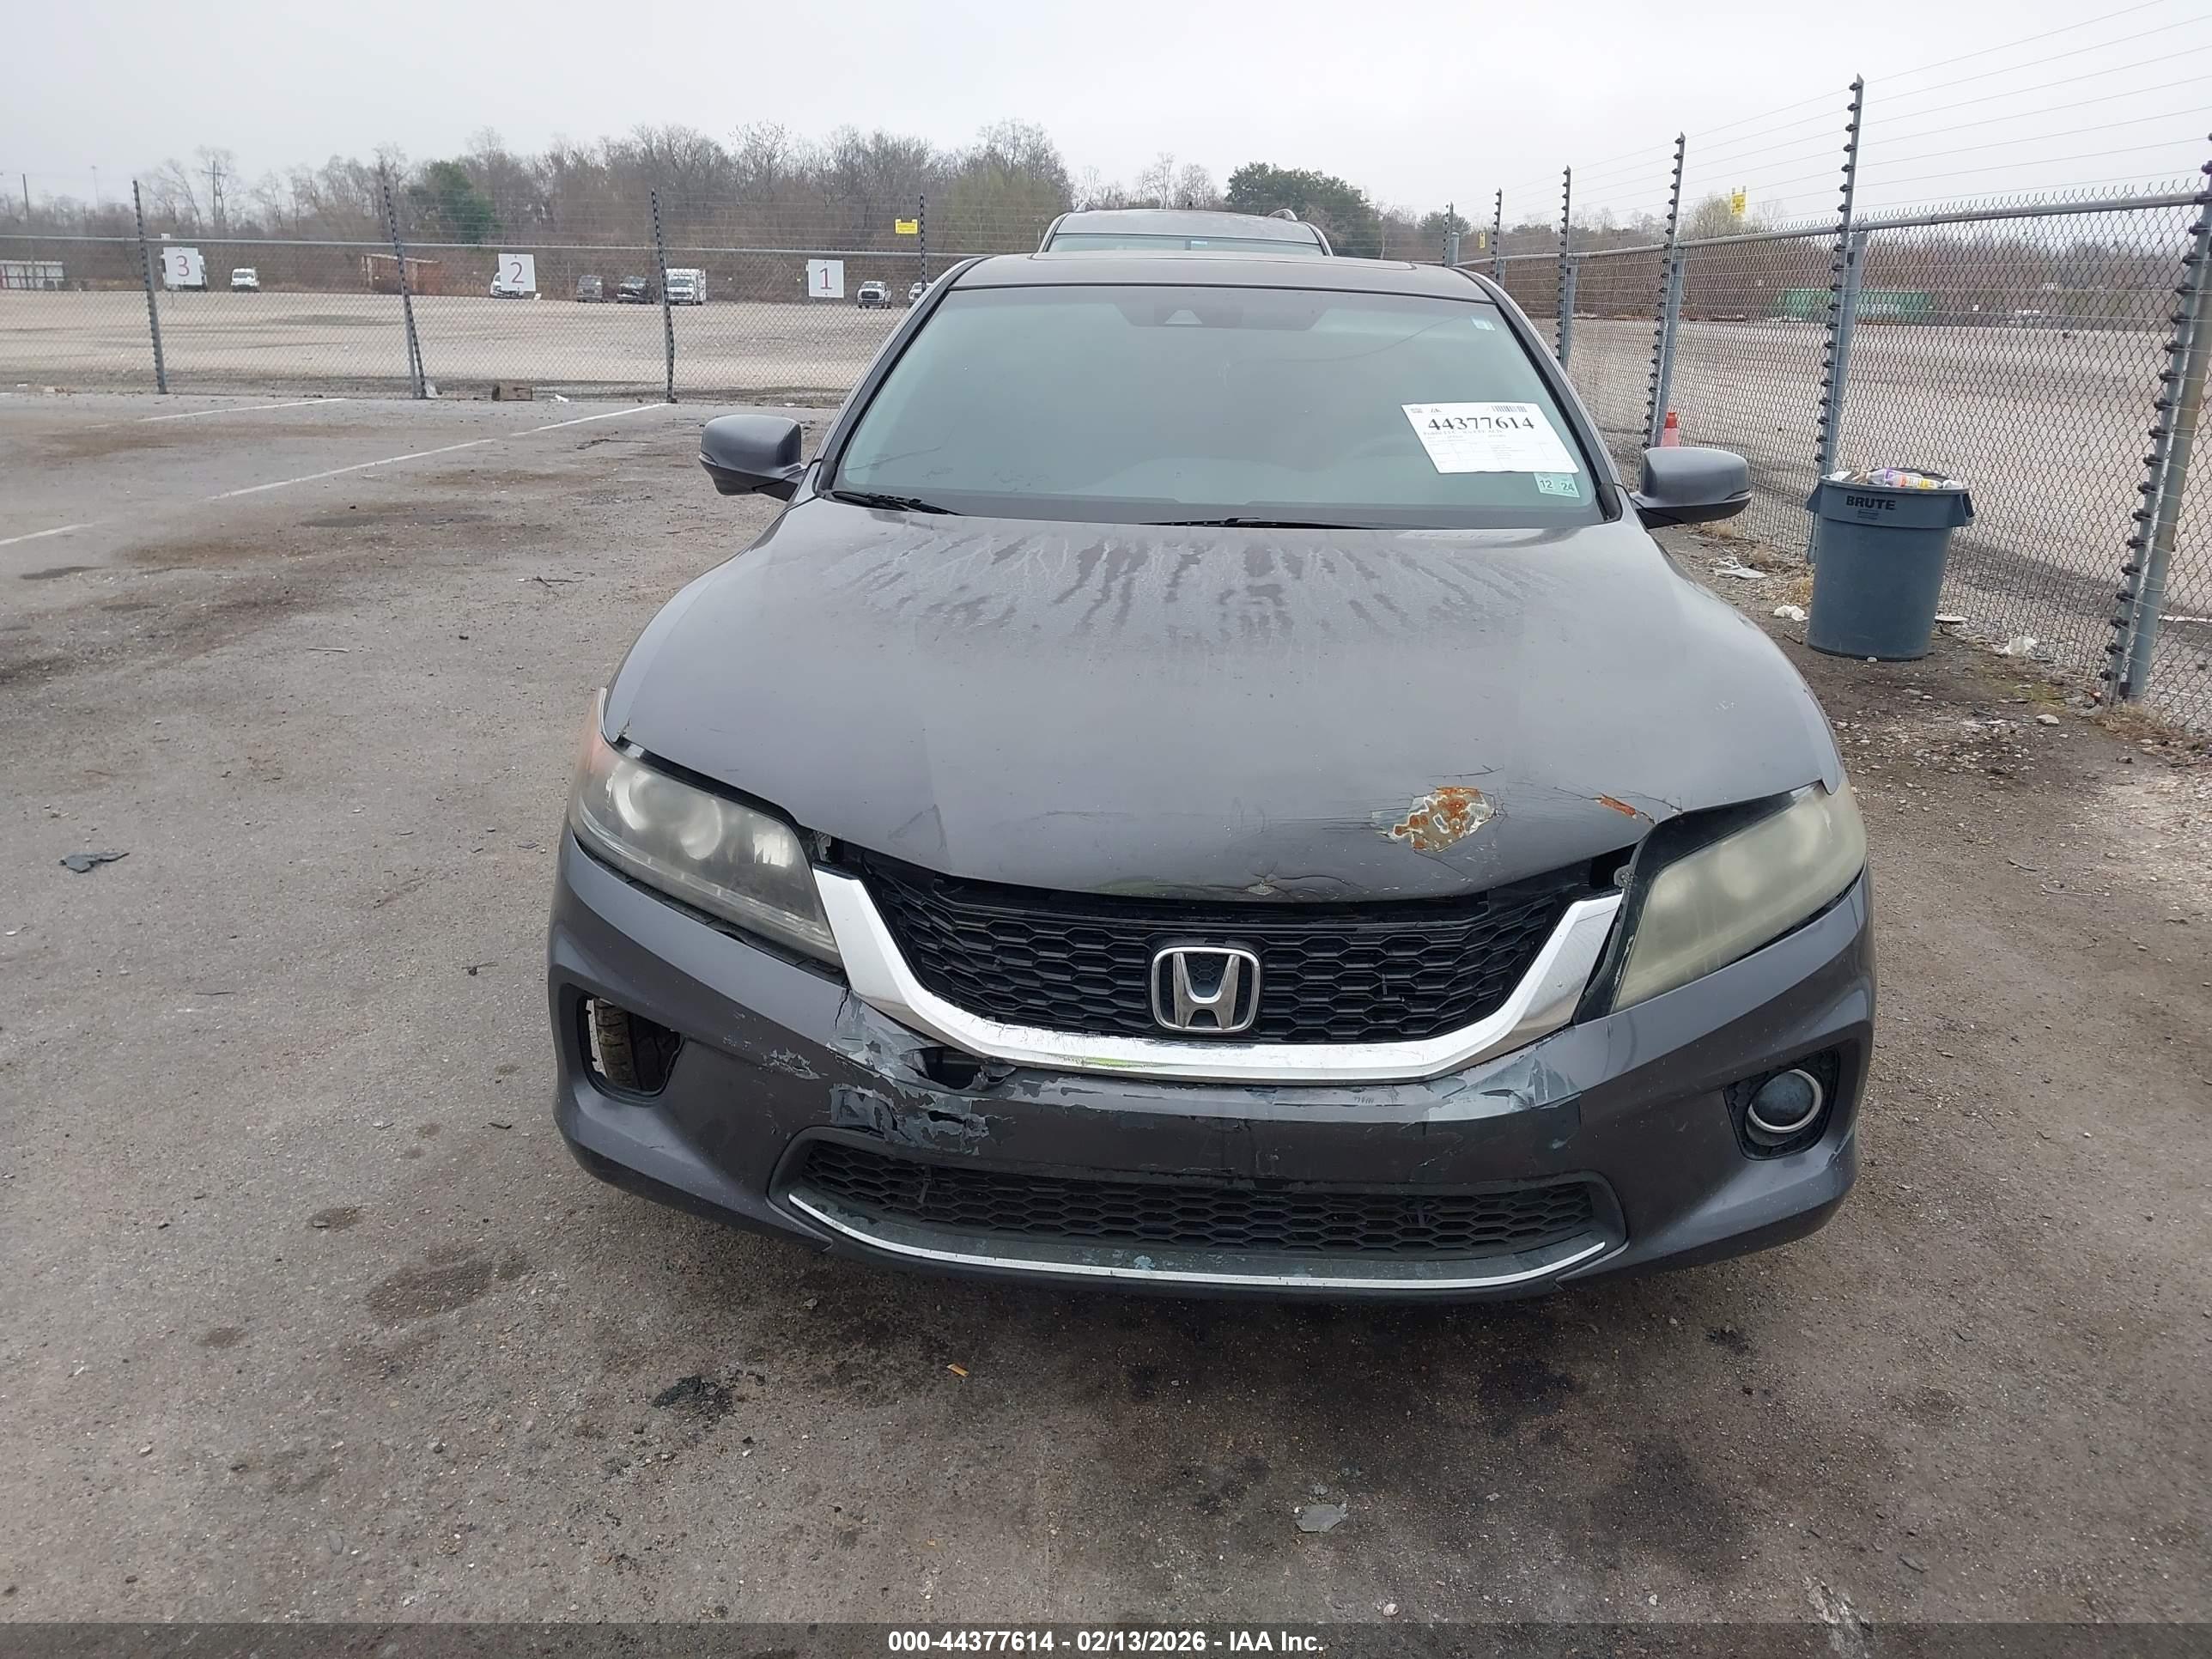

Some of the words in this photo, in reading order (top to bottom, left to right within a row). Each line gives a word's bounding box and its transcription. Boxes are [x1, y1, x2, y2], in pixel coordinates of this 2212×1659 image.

[175, 255, 190, 276] 3
[510, 261, 525, 283] 2
[819, 267, 833, 289] 1
[1428, 416, 1534, 430] 44377614
[1540, 479, 1553, 489] 12
[1560, 482, 1576, 492] 24
[1846, 495, 1896, 510] BRUTE
